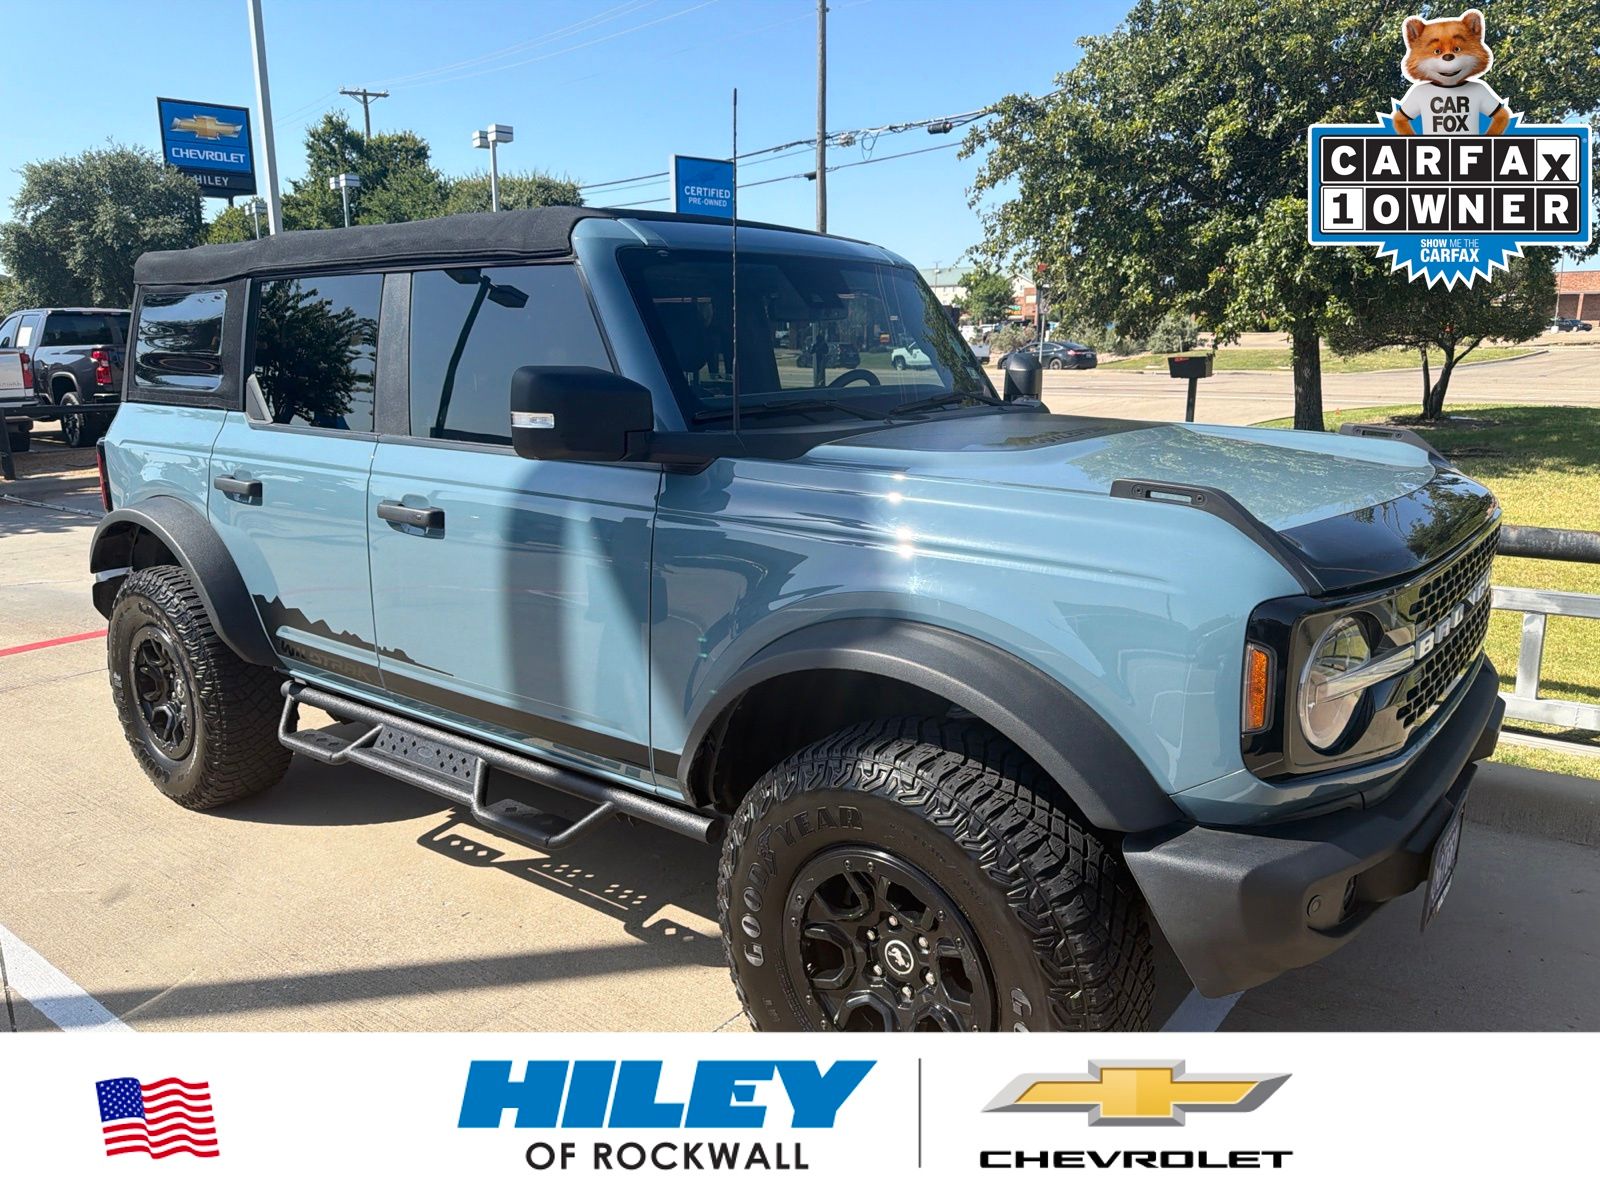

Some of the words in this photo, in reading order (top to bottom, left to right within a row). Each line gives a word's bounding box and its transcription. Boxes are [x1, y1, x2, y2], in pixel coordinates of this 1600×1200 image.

[172, 147, 245, 163] CHEVROLET
[195, 174, 229, 186] HILEY
[684, 186, 731, 199] CERTIFIED
[688, 197, 728, 207] PRE-OWNED
